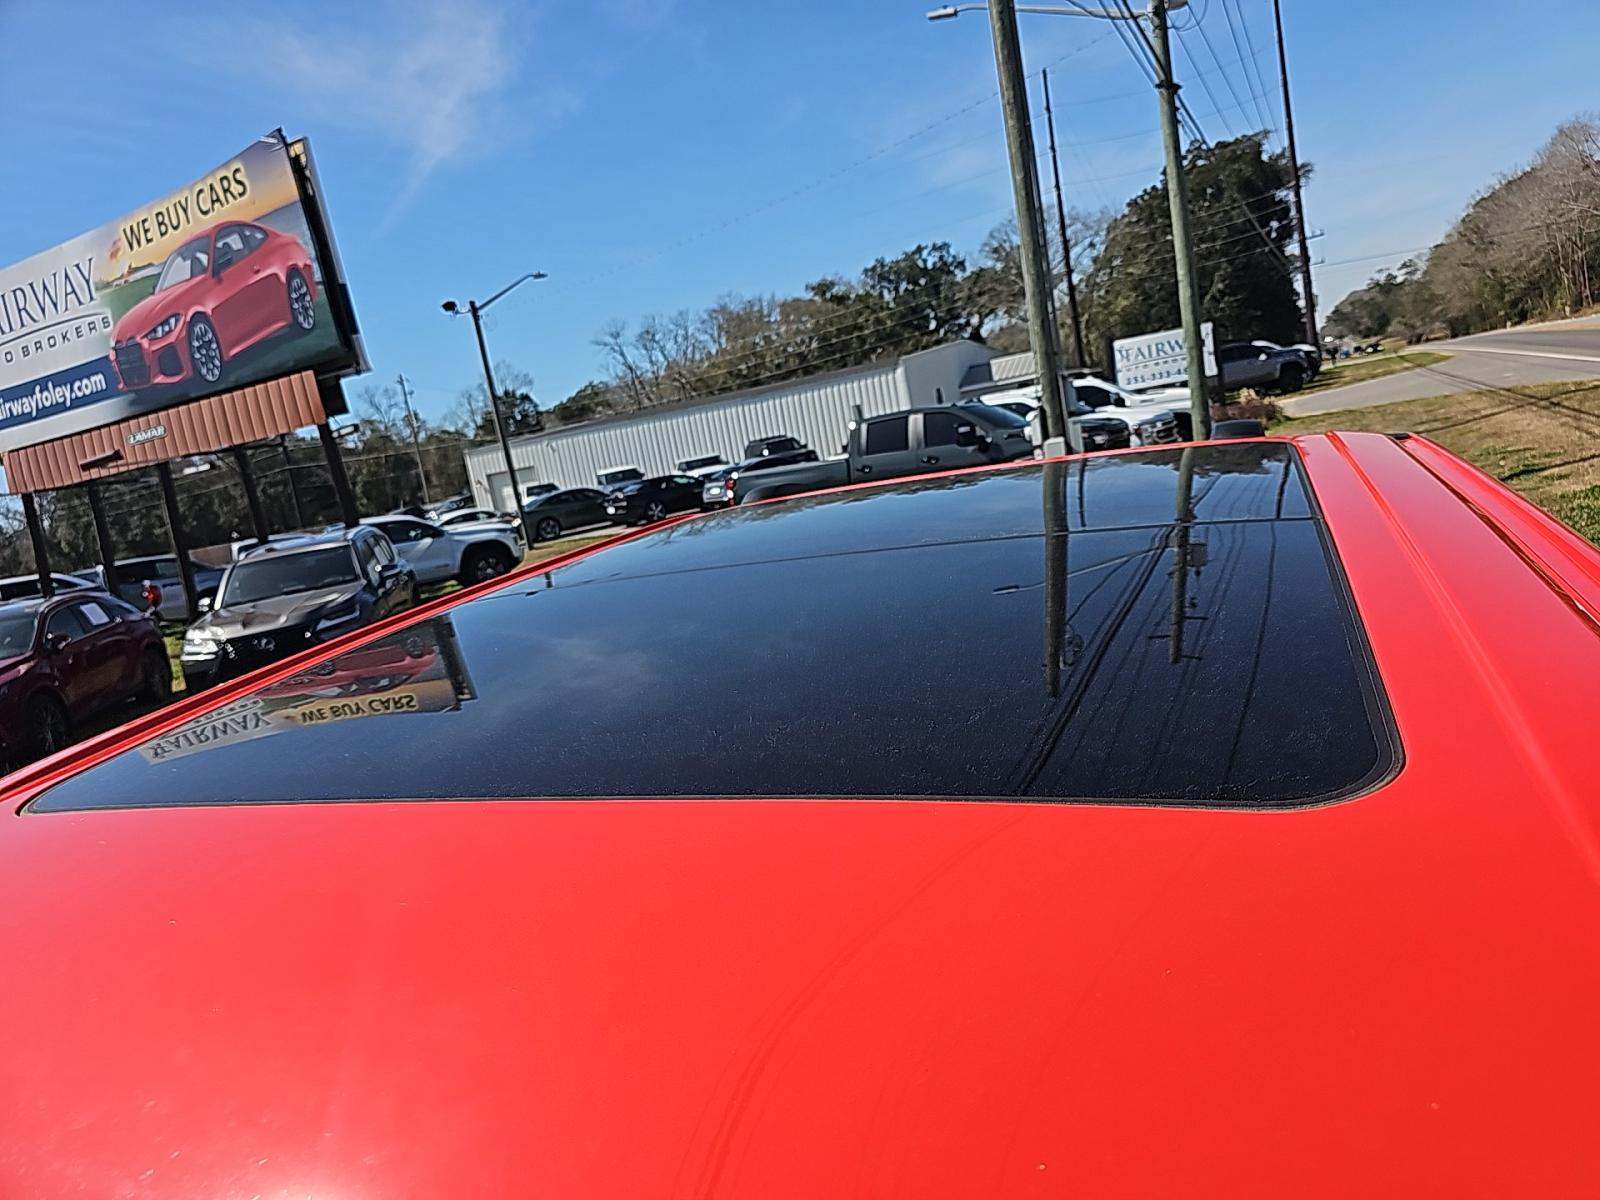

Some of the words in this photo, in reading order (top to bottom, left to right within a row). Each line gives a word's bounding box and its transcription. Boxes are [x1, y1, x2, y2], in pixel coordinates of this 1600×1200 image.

[122, 216, 154, 252] WE
[154, 195, 191, 239] BUY
[195, 167, 248, 217] CARS
[0, 257, 97, 335] IRWAY
[21, 315, 111, 358] BROKERS
